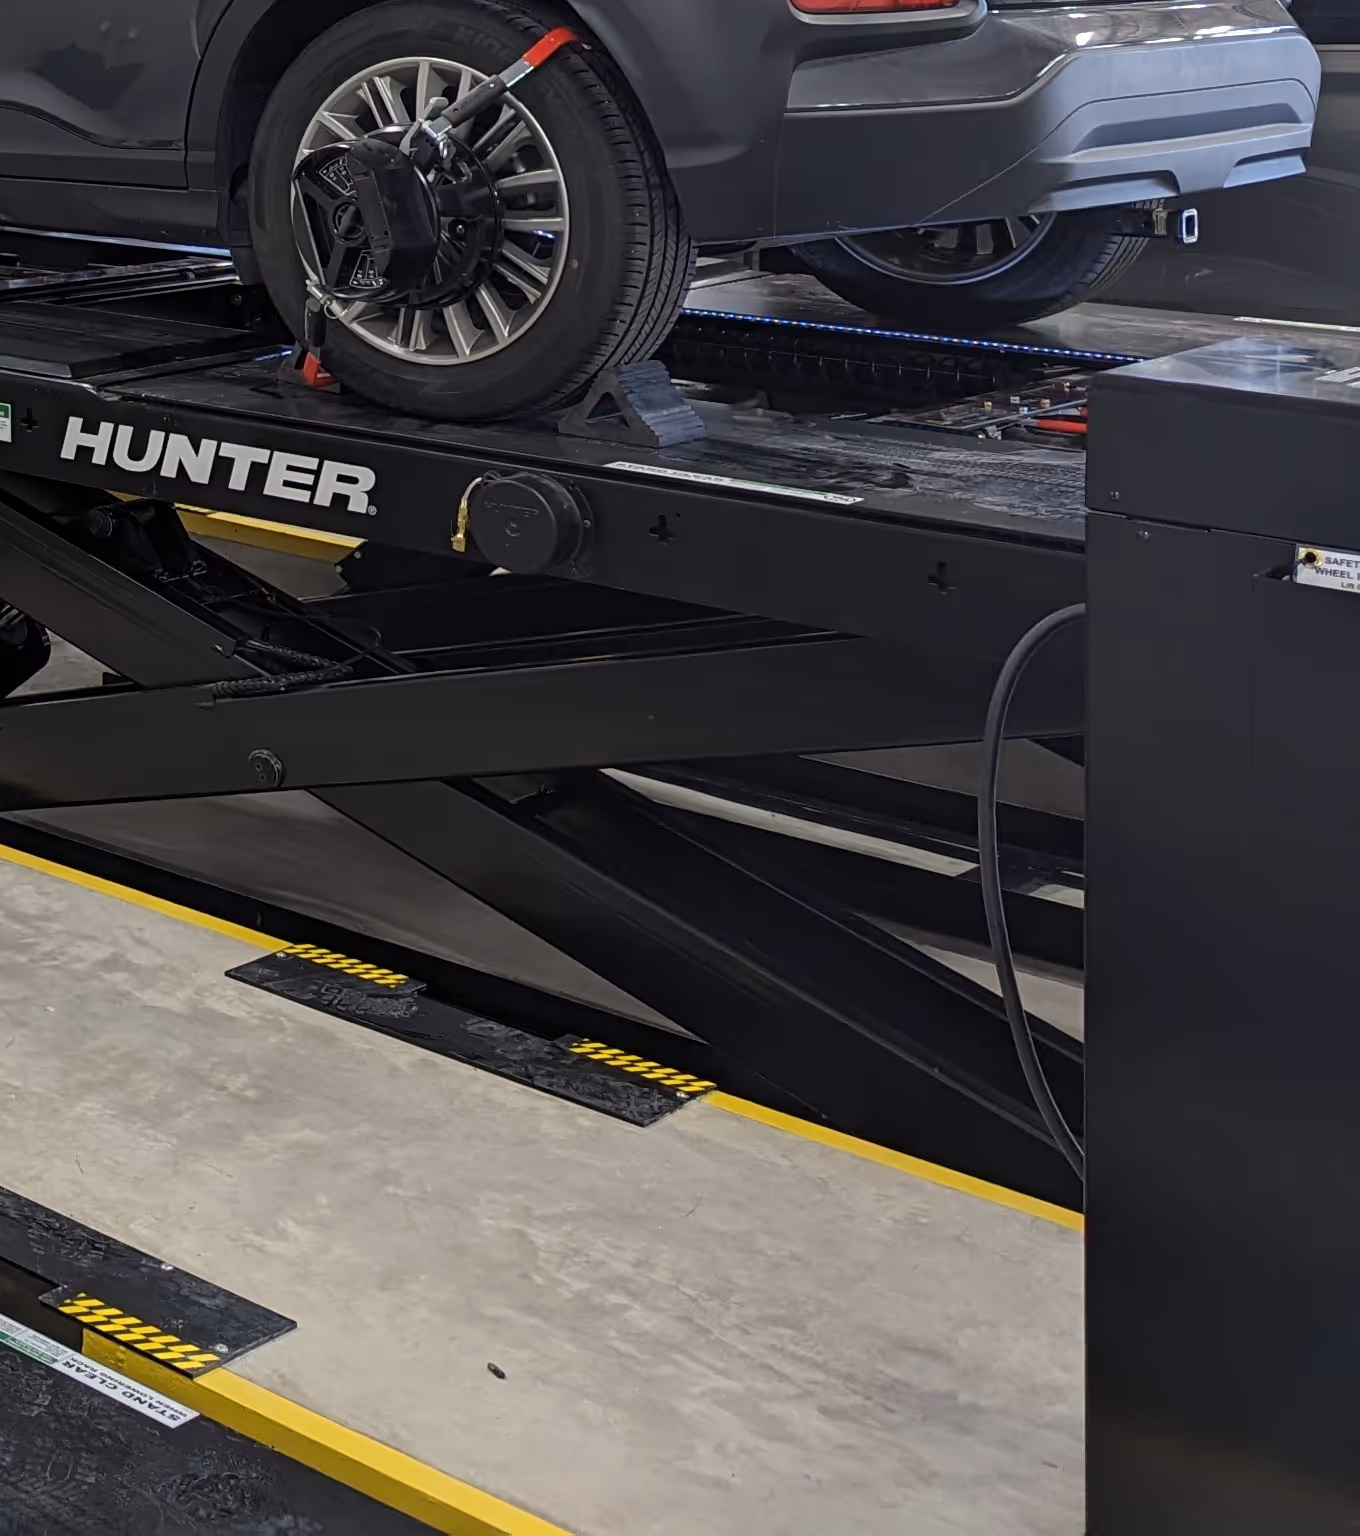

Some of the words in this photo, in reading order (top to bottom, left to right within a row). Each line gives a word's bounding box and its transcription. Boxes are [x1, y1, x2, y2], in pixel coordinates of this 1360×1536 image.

[60, 416, 376, 514] HUNTER
[1314, 567, 1354, 580] WHEEL
[61, 1360, 120, 1391] CLEAR
[69, 1356, 98, 1372] RACK
[98, 1371, 157, 1400] LOWERING
[121, 1390, 182, 1422] STAND
[154, 1398, 188, 1418] WHEN
